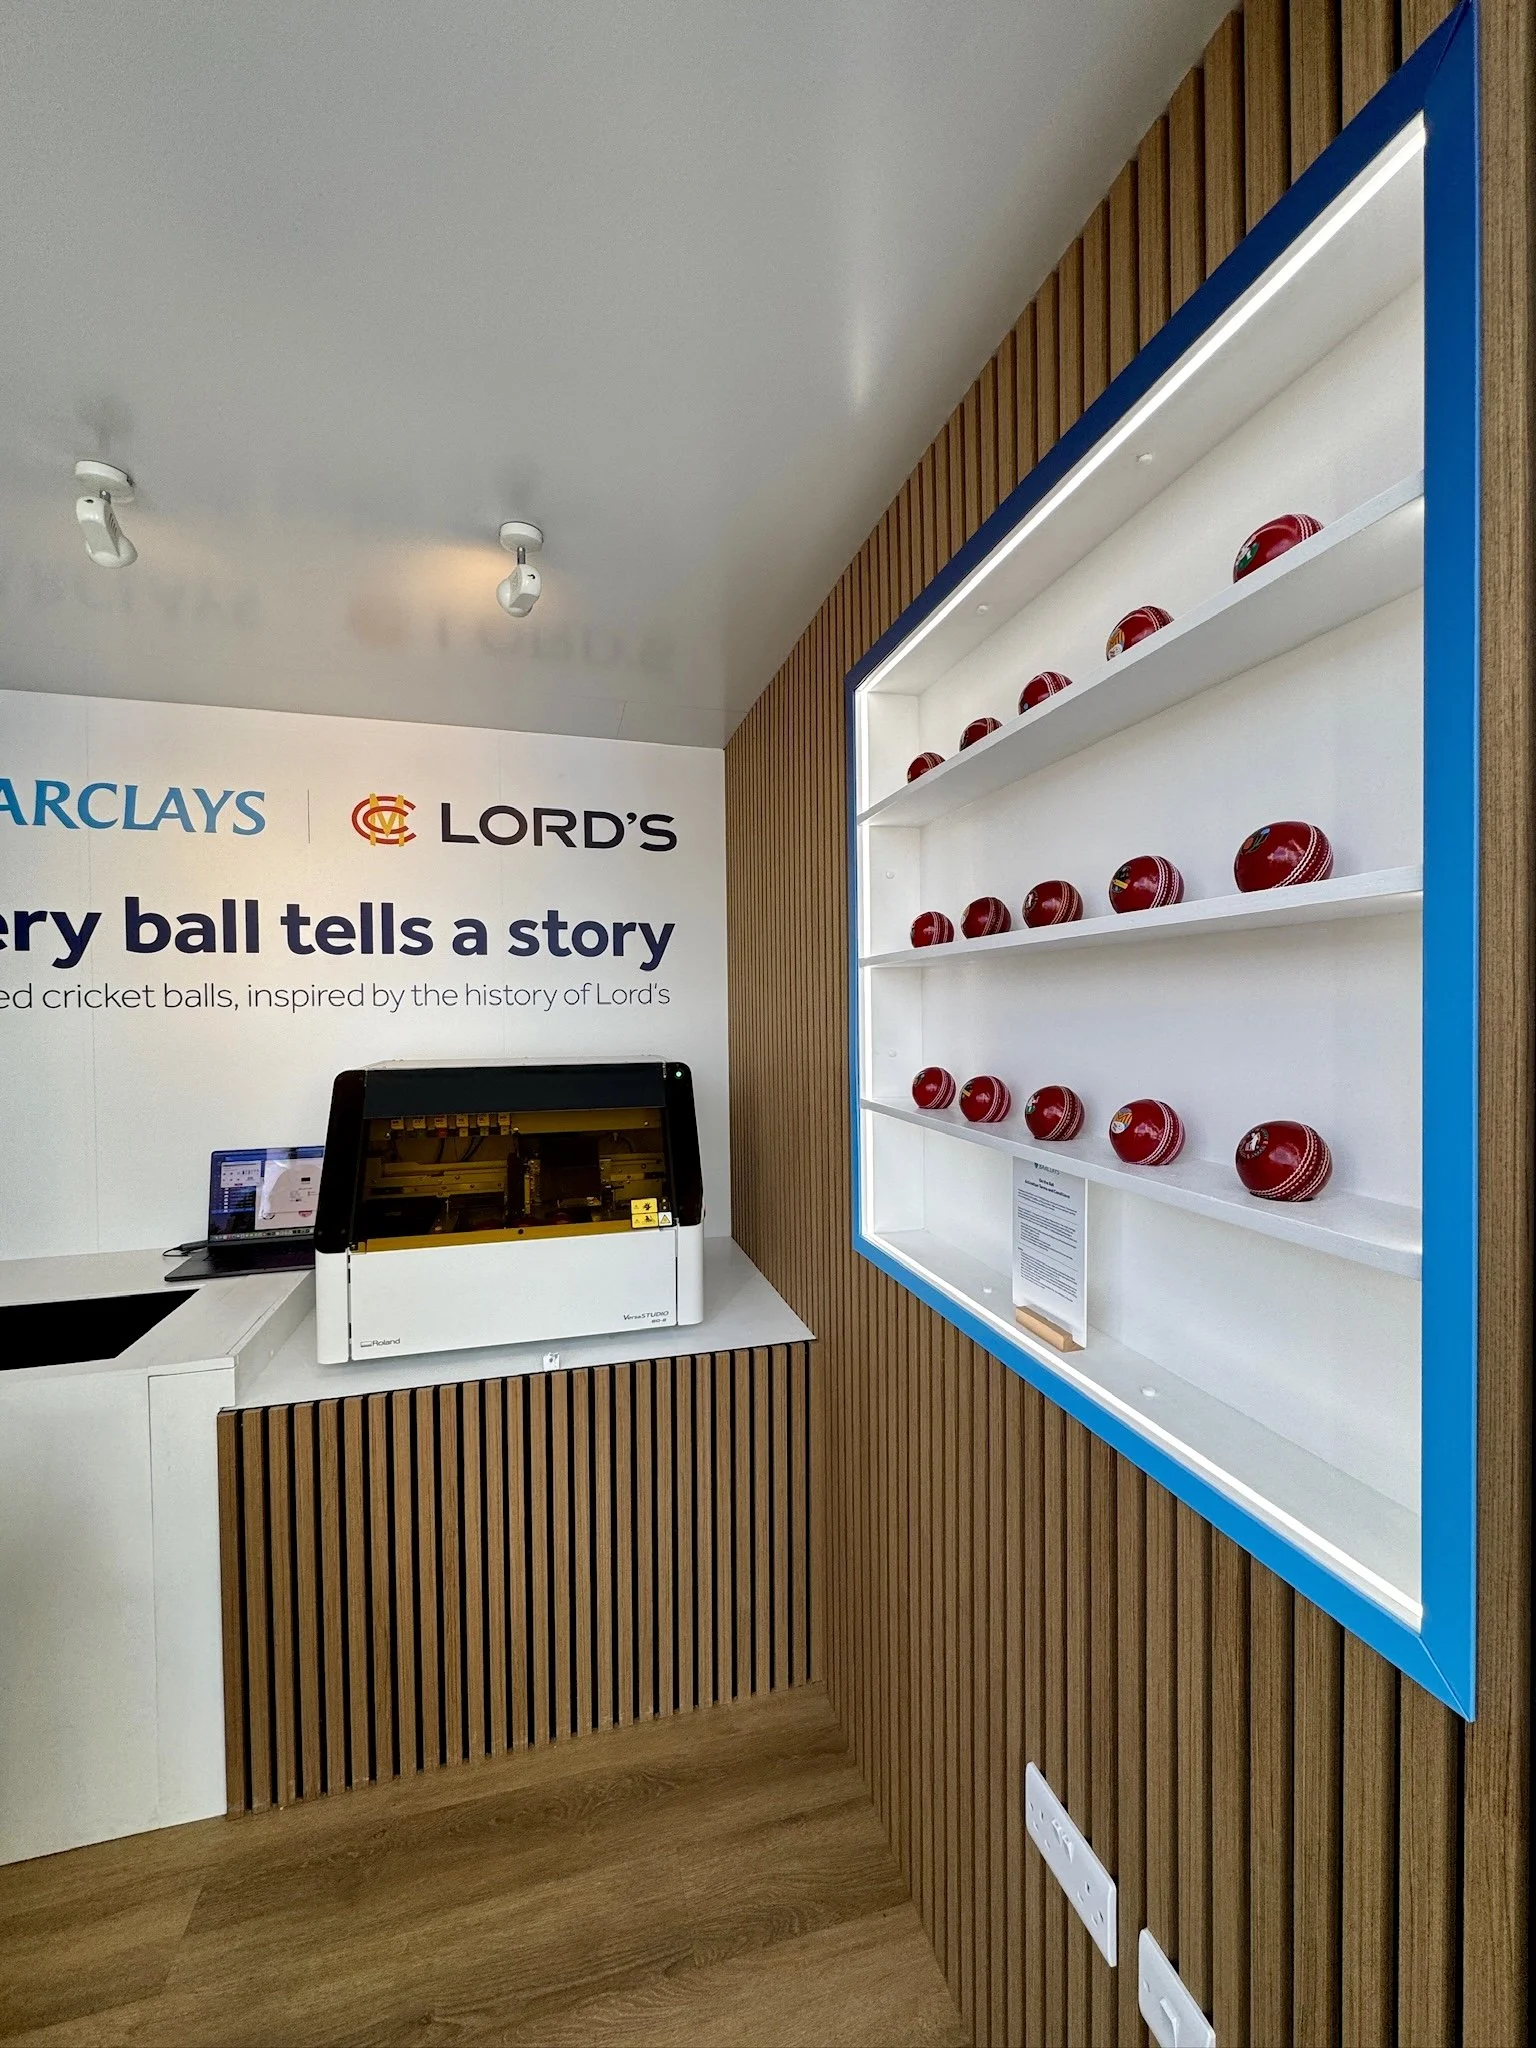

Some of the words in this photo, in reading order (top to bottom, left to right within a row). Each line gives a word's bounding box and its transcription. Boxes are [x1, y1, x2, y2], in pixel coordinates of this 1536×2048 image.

[441, 802, 678, 852] LORD'S
[0, 910, 102, 969] ry
[125, 896, 260, 954] ball
[280, 902, 434, 956] tells
[452, 918, 488, 956] a
[508, 909, 676, 972] story
[42, 984, 157, 1009] cricket
[164, 983, 239, 1011] balls,
[248, 983, 364, 1014] inspired
[373, 983, 405, 1013] by
[411, 983, 458, 1007] the
[465, 983, 558, 1012] history
[563, 982, 591, 1006] of
[597, 983, 671, 1005] Lord's
[372, 1337, 401, 1347] Roland
